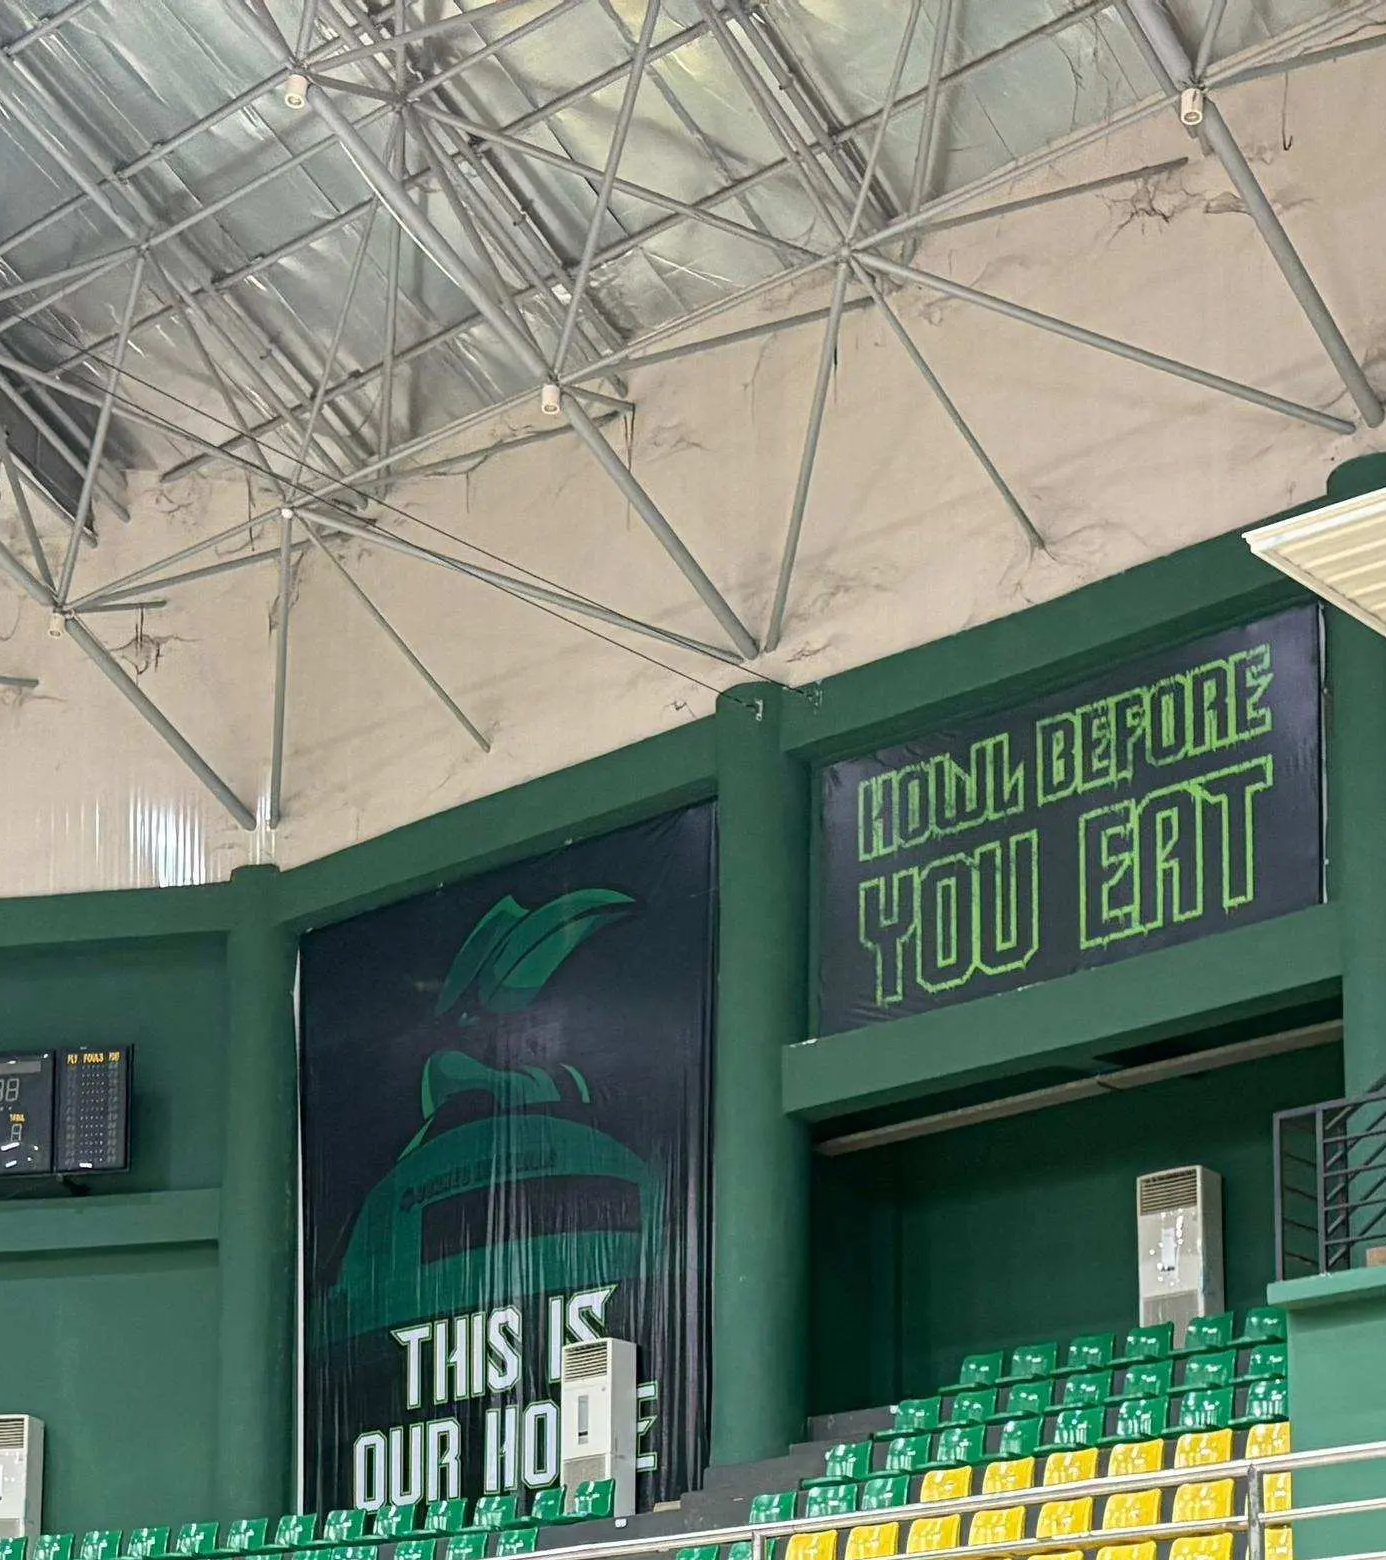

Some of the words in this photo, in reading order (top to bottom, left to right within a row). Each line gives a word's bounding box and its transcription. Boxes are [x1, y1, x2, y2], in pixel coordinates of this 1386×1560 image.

[858, 733, 1024, 862] HOWL
[1036, 642, 1273, 806] BEFORE
[859, 828, 1039, 1003] YOU
[1079, 754, 1273, 949] EAT
[390, 1304, 523, 1410] THIS
[548, 1284, 619, 1384] IS
[354, 1416, 462, 1514] OUR
[484, 1380, 659, 1496] HOE
